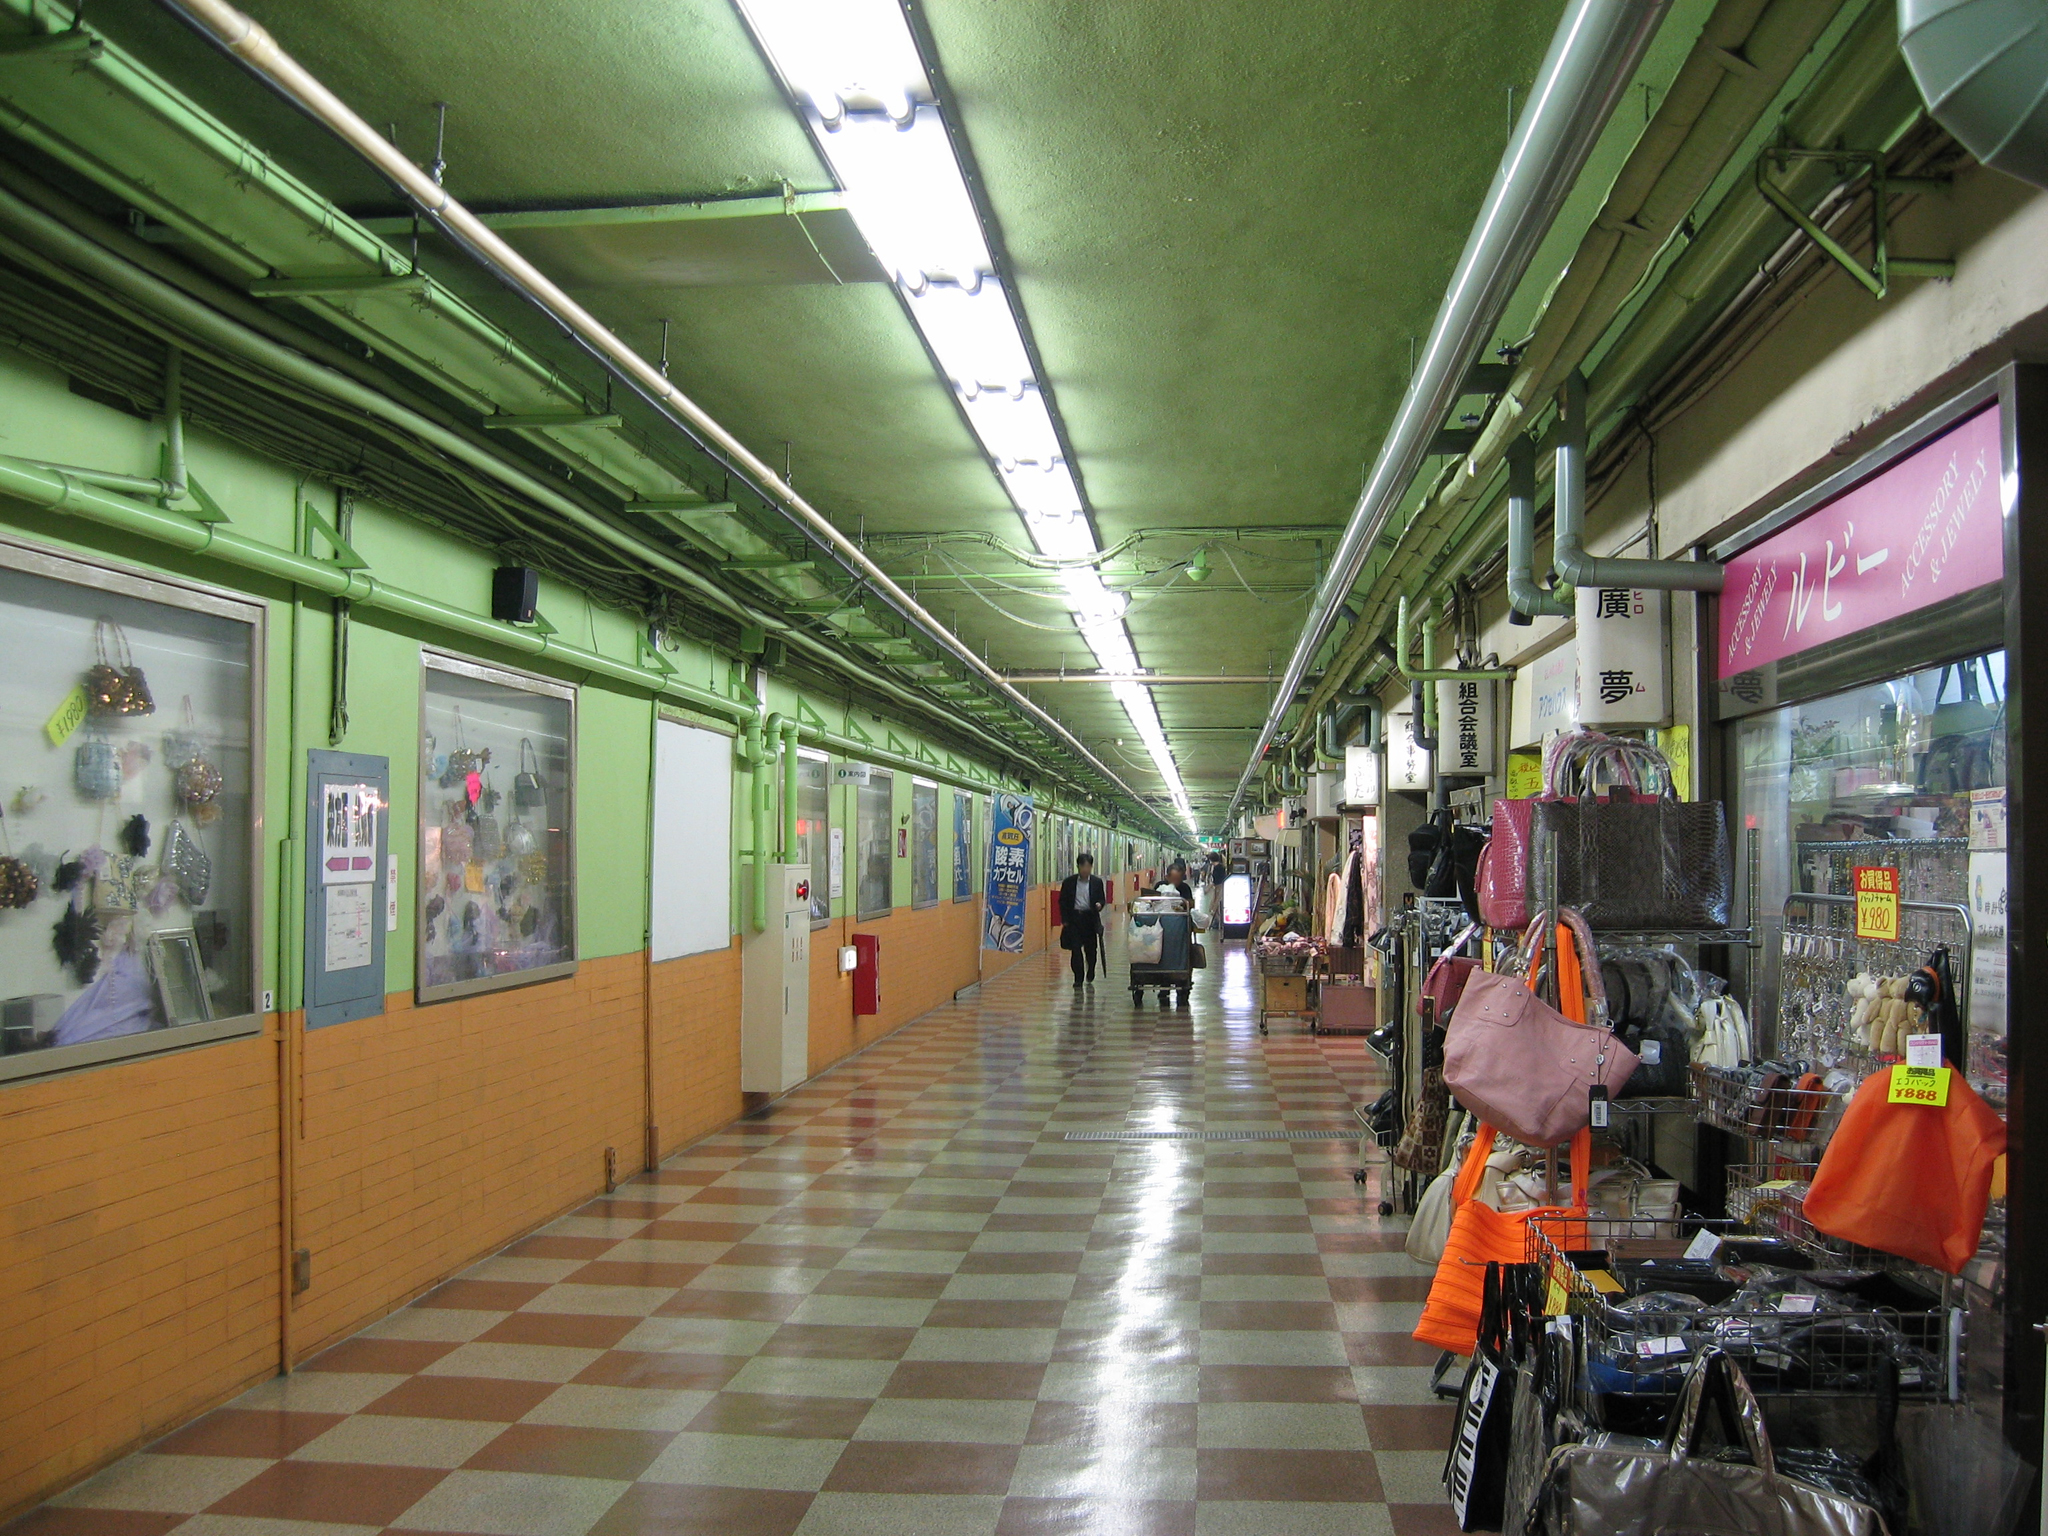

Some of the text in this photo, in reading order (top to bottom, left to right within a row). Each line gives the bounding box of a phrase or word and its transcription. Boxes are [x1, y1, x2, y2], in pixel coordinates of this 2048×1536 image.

[1901, 449, 1960, 599] ACCESSORY
[1930, 447, 1988, 584] & JEWELY
[1744, 559, 1778, 656] & JEWELY
[1782, 520, 1888, 642] ルビー
[1728, 558, 1763, 665] ACCESSORY
[1458, 682, 1479, 768] 組合会議室
[992, 866, 1024, 885] カプセル
[995, 845, 1025, 868] 酸素
[1860, 869, 1893, 891] お買得品
[1861, 906, 1890, 930] ¥980
[265, 992, 271, 1009] 2
[1895, 1088, 1938, 1101] ¥888
